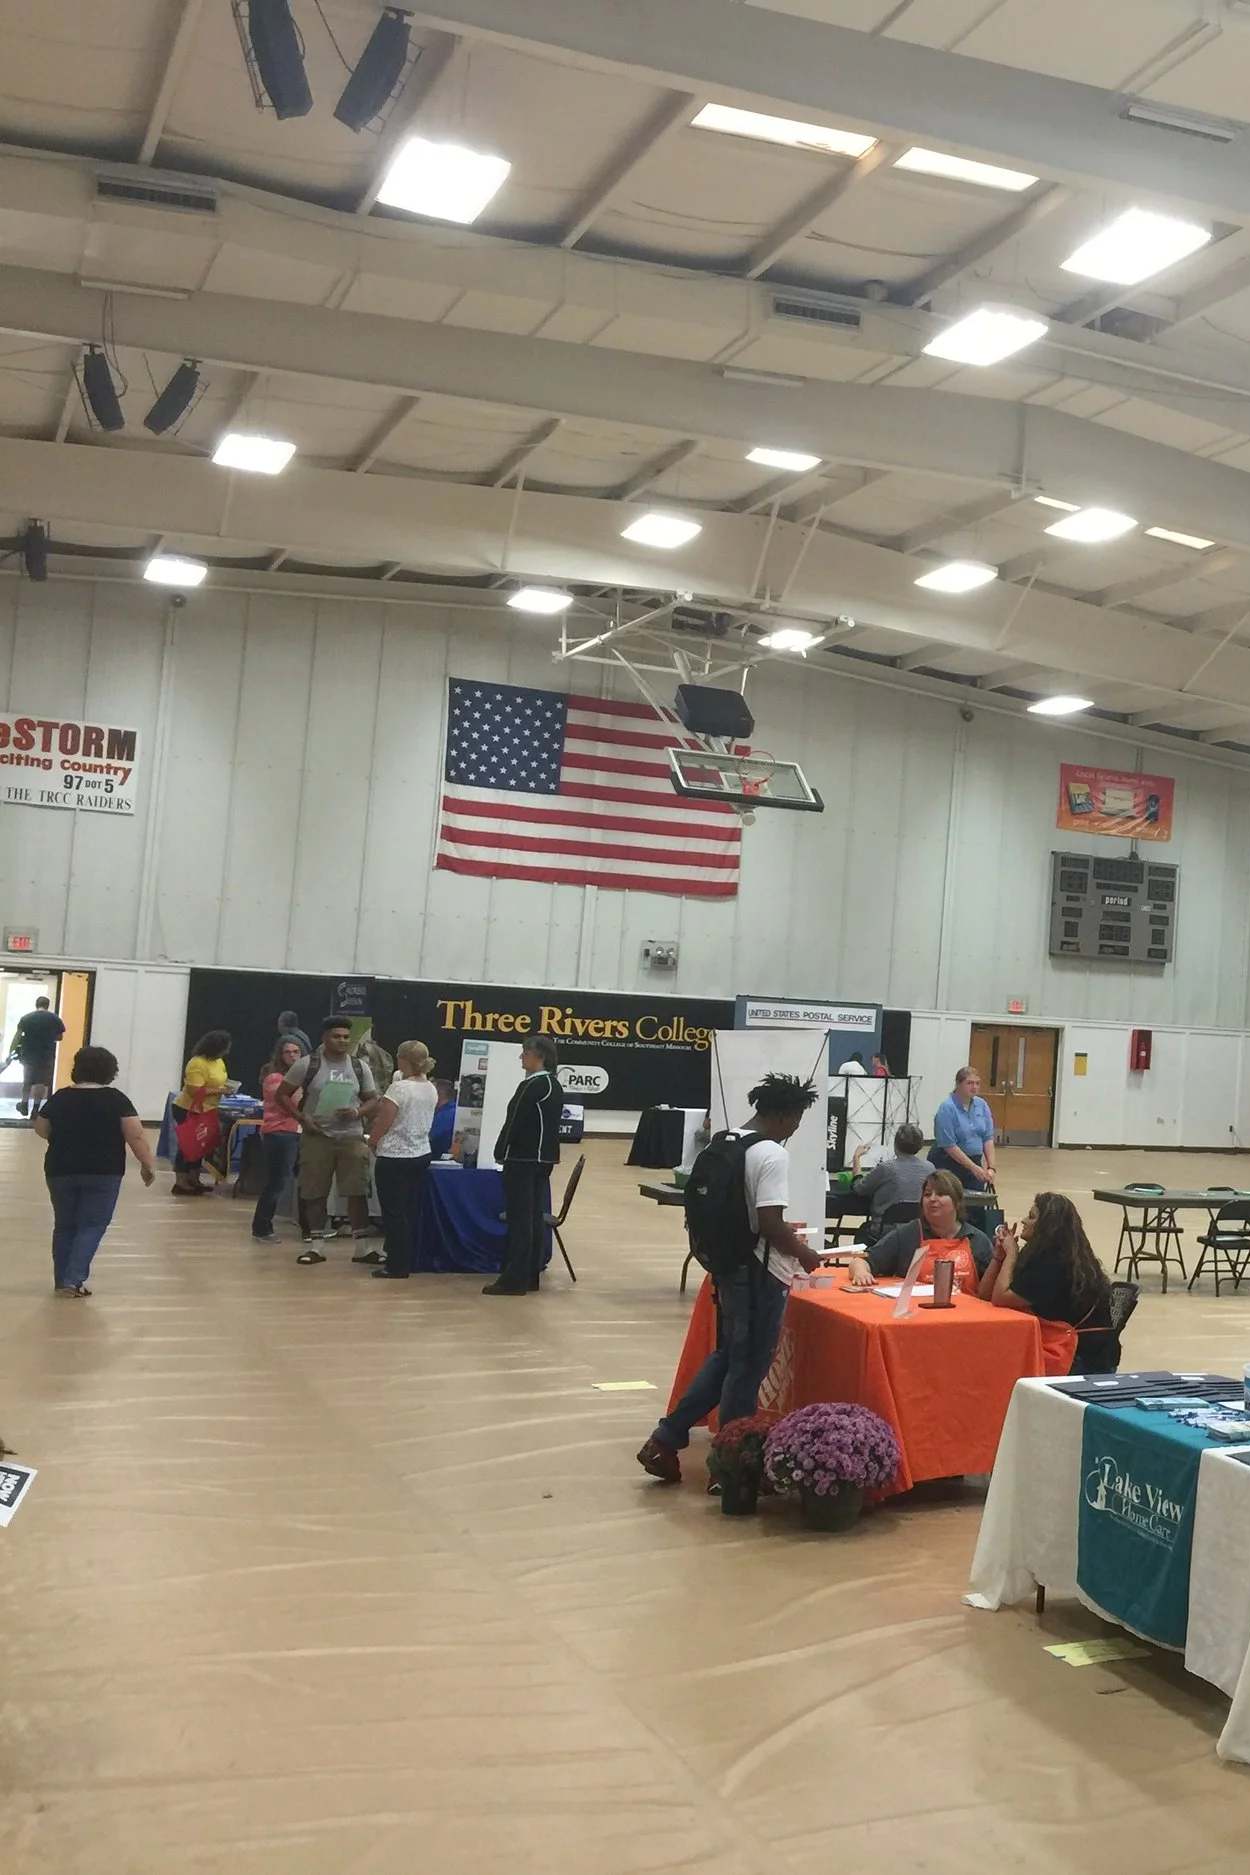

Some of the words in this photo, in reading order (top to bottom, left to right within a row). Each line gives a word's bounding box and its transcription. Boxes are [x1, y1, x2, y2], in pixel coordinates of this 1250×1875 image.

[60, 759, 132, 786] country
[63, 774, 84, 790] 97
[85, 780, 102, 789] DOT
[104, 778, 114, 793] 5
[7, 787, 32, 801] THE
[40, 790, 72, 805] TRCC
[76, 793, 132, 811] RAIDERS
[436, 999, 531, 1033] Three
[537, 1006, 629, 1039] Rivers
[748, 1009, 771, 1017] UNITED
[773, 1010, 800, 1018] STATES
[803, 1011, 834, 1020] POSTAL
[837, 1014, 873, 1023] SERVICE
[568, 1075, 601, 1087] PARC
[827, 1114, 839, 1150] Skyline
[1103, 1464, 1141, 1503] Lake
[1145, 1484, 1184, 1522] View
[1121, 1498, 1149, 1528] Home
[1150, 1514, 1171, 1540] Care
